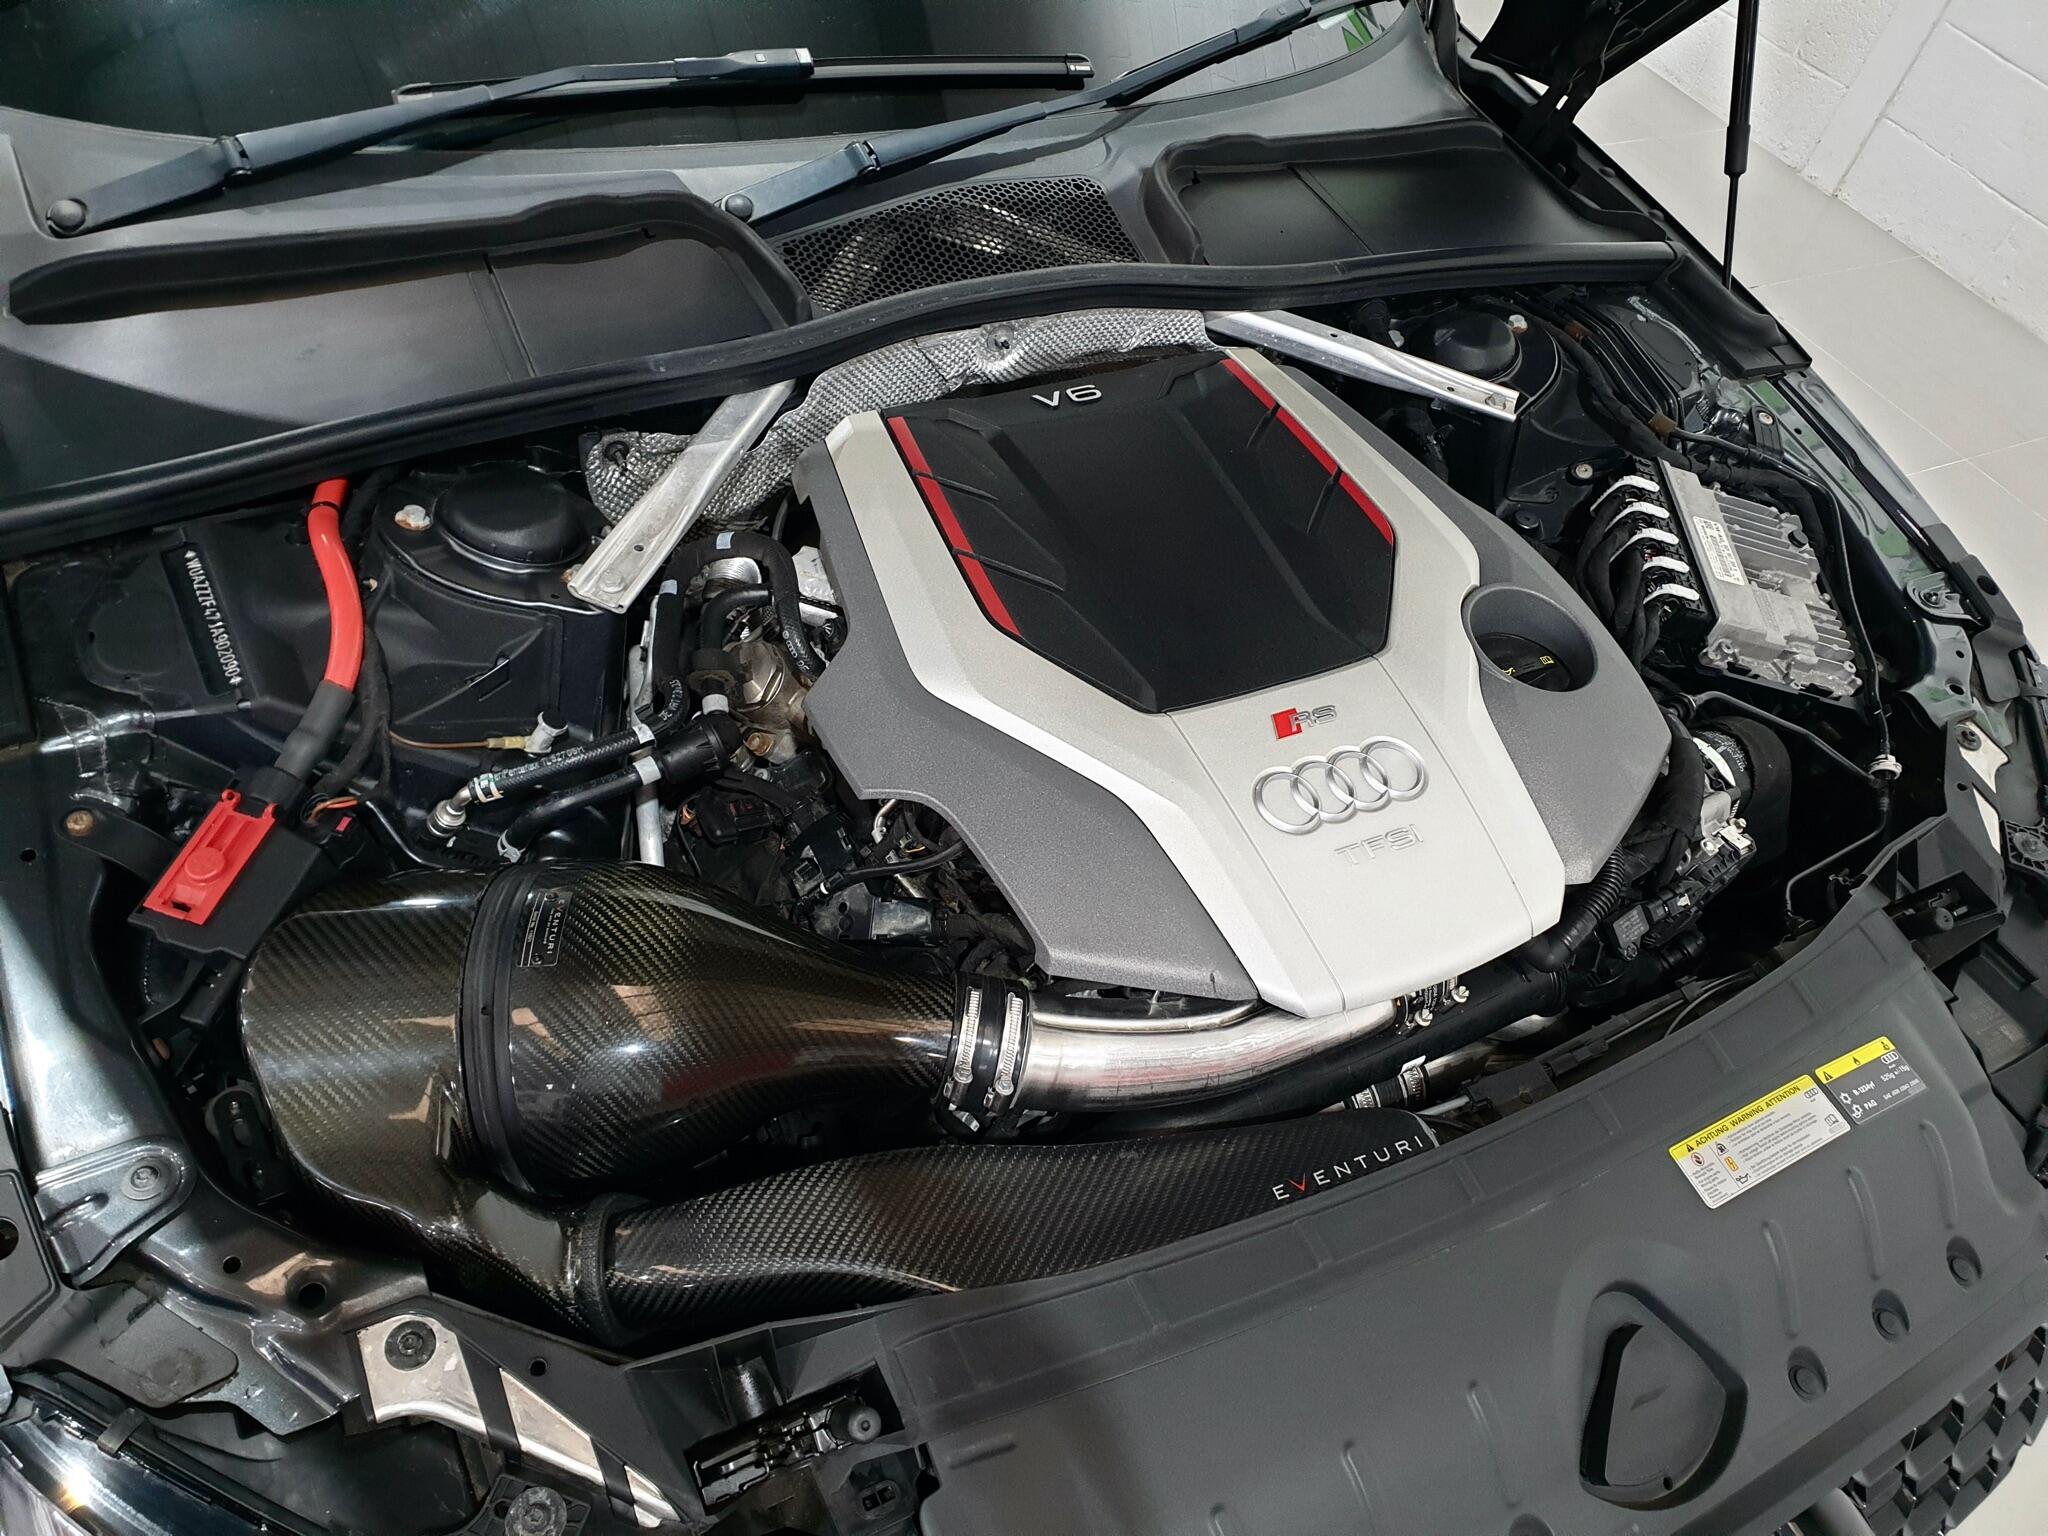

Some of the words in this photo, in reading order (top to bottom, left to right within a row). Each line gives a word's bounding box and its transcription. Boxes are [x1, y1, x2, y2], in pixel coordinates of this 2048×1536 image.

[1031, 384, 1102, 407] V6
[1289, 704, 1338, 733] RS
[1334, 823, 1424, 866] TFSI
[546, 898, 566, 954] EVENTURI
[1694, 1124, 1730, 1148] ACHTUNG
[1730, 1105, 1765, 1128] WARNING
[1765, 1084, 1801, 1109] ATTENTION
[1271, 1135, 1424, 1201] EVENTURI
